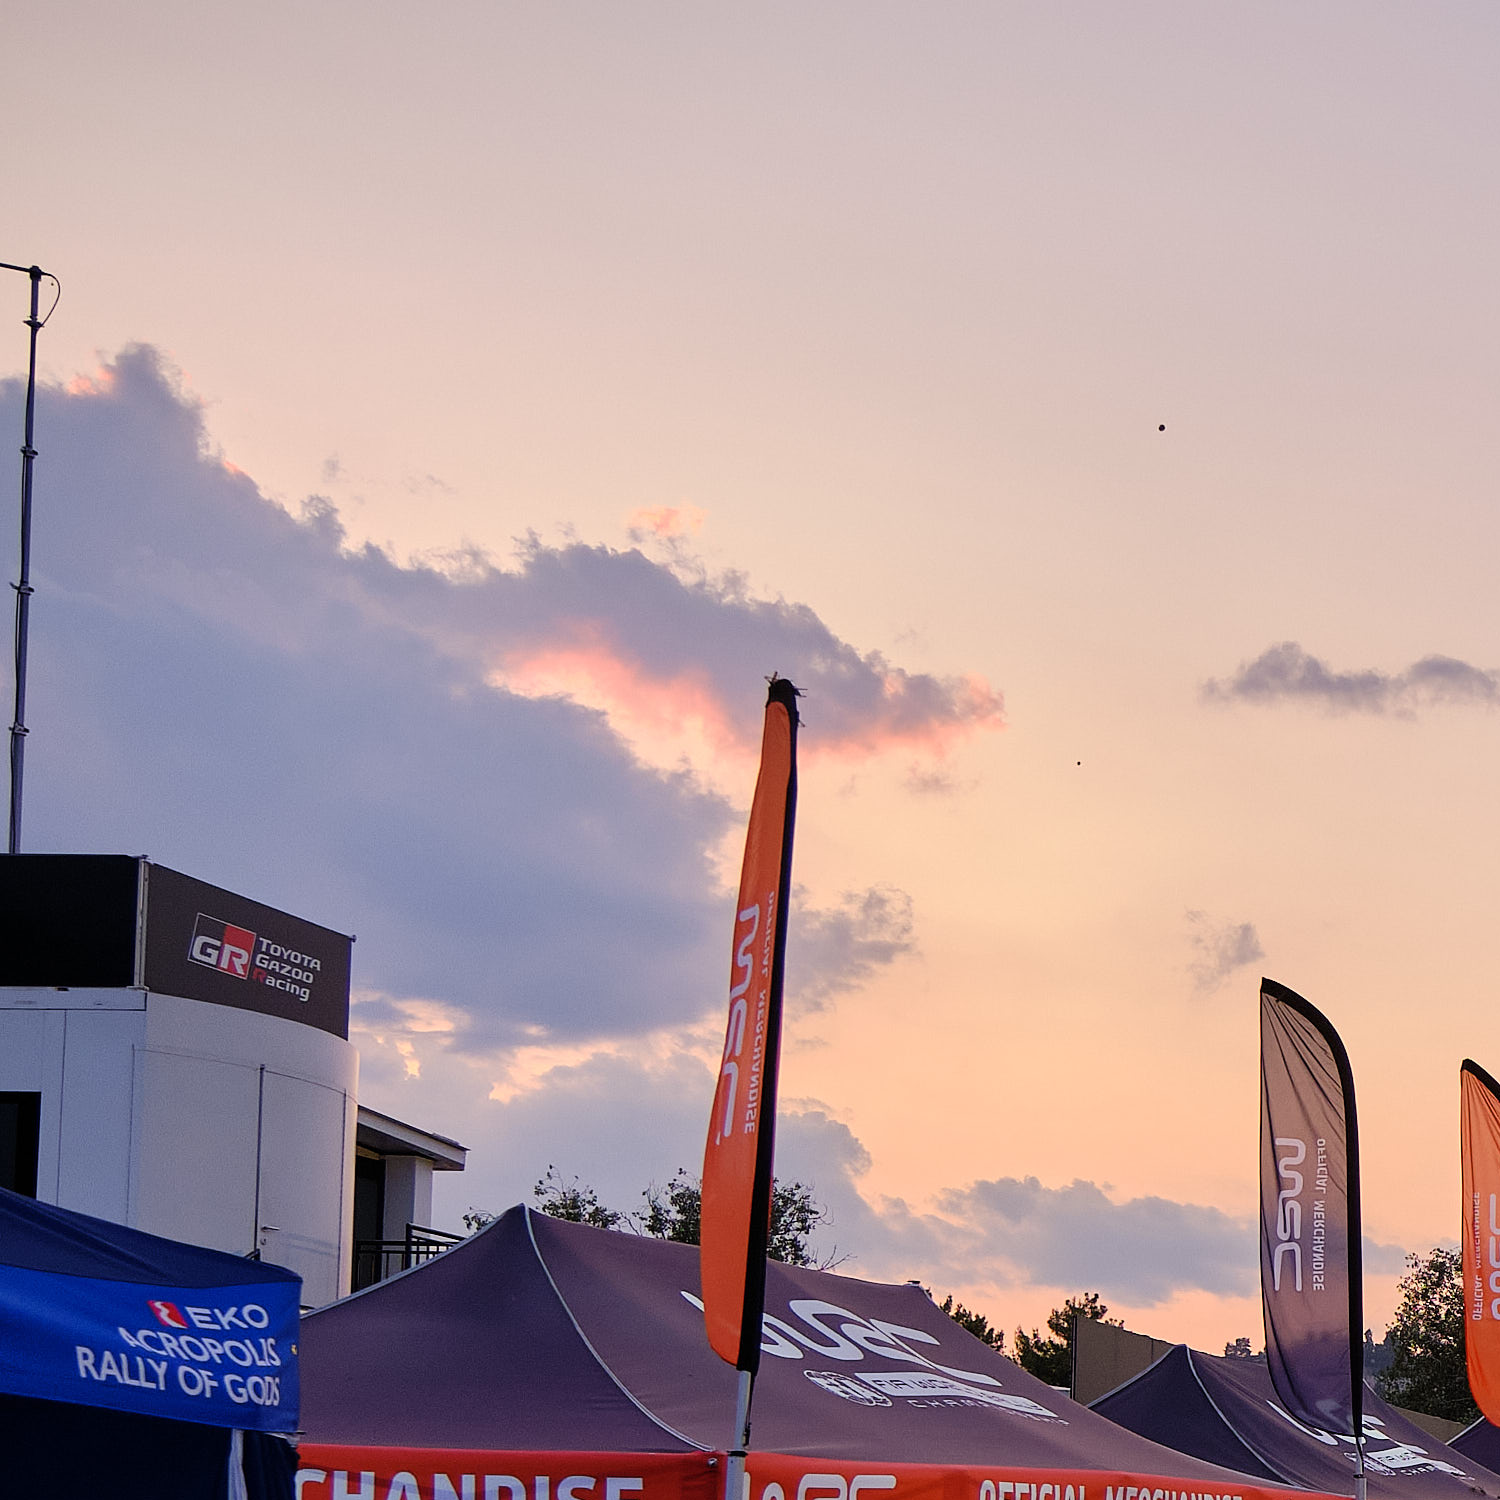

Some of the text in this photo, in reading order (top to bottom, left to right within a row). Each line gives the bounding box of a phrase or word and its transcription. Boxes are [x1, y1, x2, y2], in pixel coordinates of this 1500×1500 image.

[192, 935, 249, 976] GR
[255, 953, 314, 984] GAZOO
[259, 937, 321, 971] TOYOTA
[252, 968, 311, 1002] Racing
[184, 1303, 270, 1331] EKO
[117, 1326, 281, 1368] ACROPOLIS
[75, 1345, 281, 1407] RALLY OF GODS
